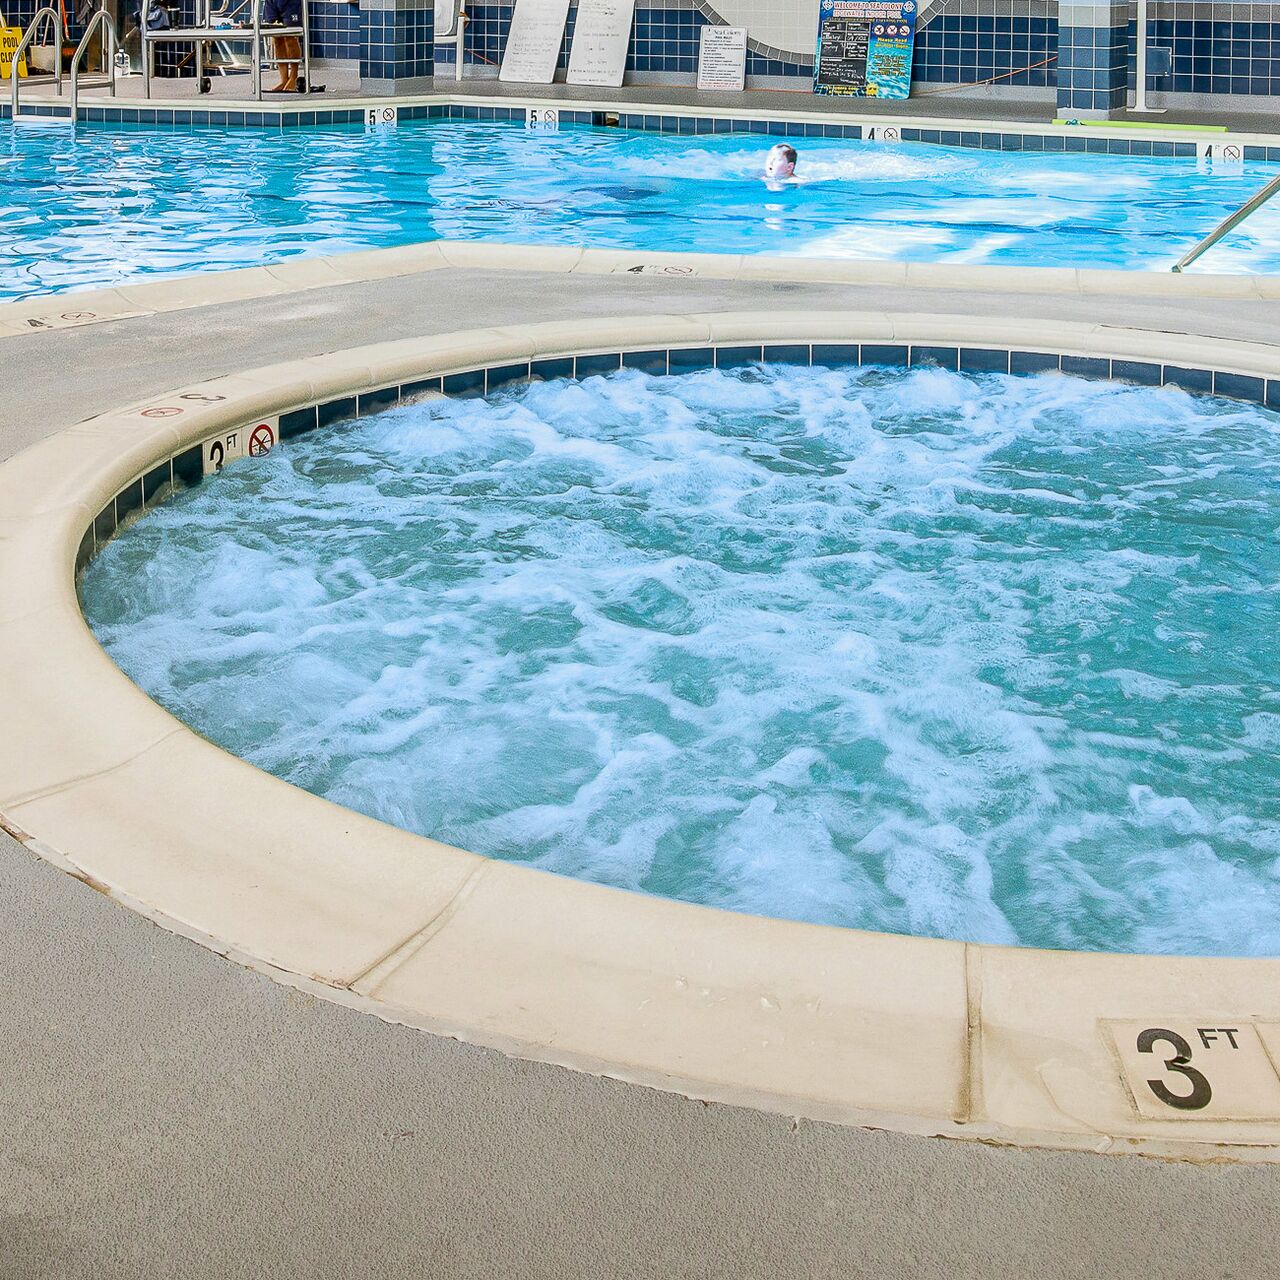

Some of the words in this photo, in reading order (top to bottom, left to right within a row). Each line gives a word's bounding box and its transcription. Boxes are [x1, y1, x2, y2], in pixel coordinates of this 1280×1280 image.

[2, 37, 19, 48] POOL
[0, 51, 25, 63] CLOD
[369, 109, 376, 126] 5
[530, 109, 537, 124] 5
[226, 433, 238, 451] FT
[1137, 1028, 1213, 1111] 3
[1197, 1028, 1239, 1050] FT
